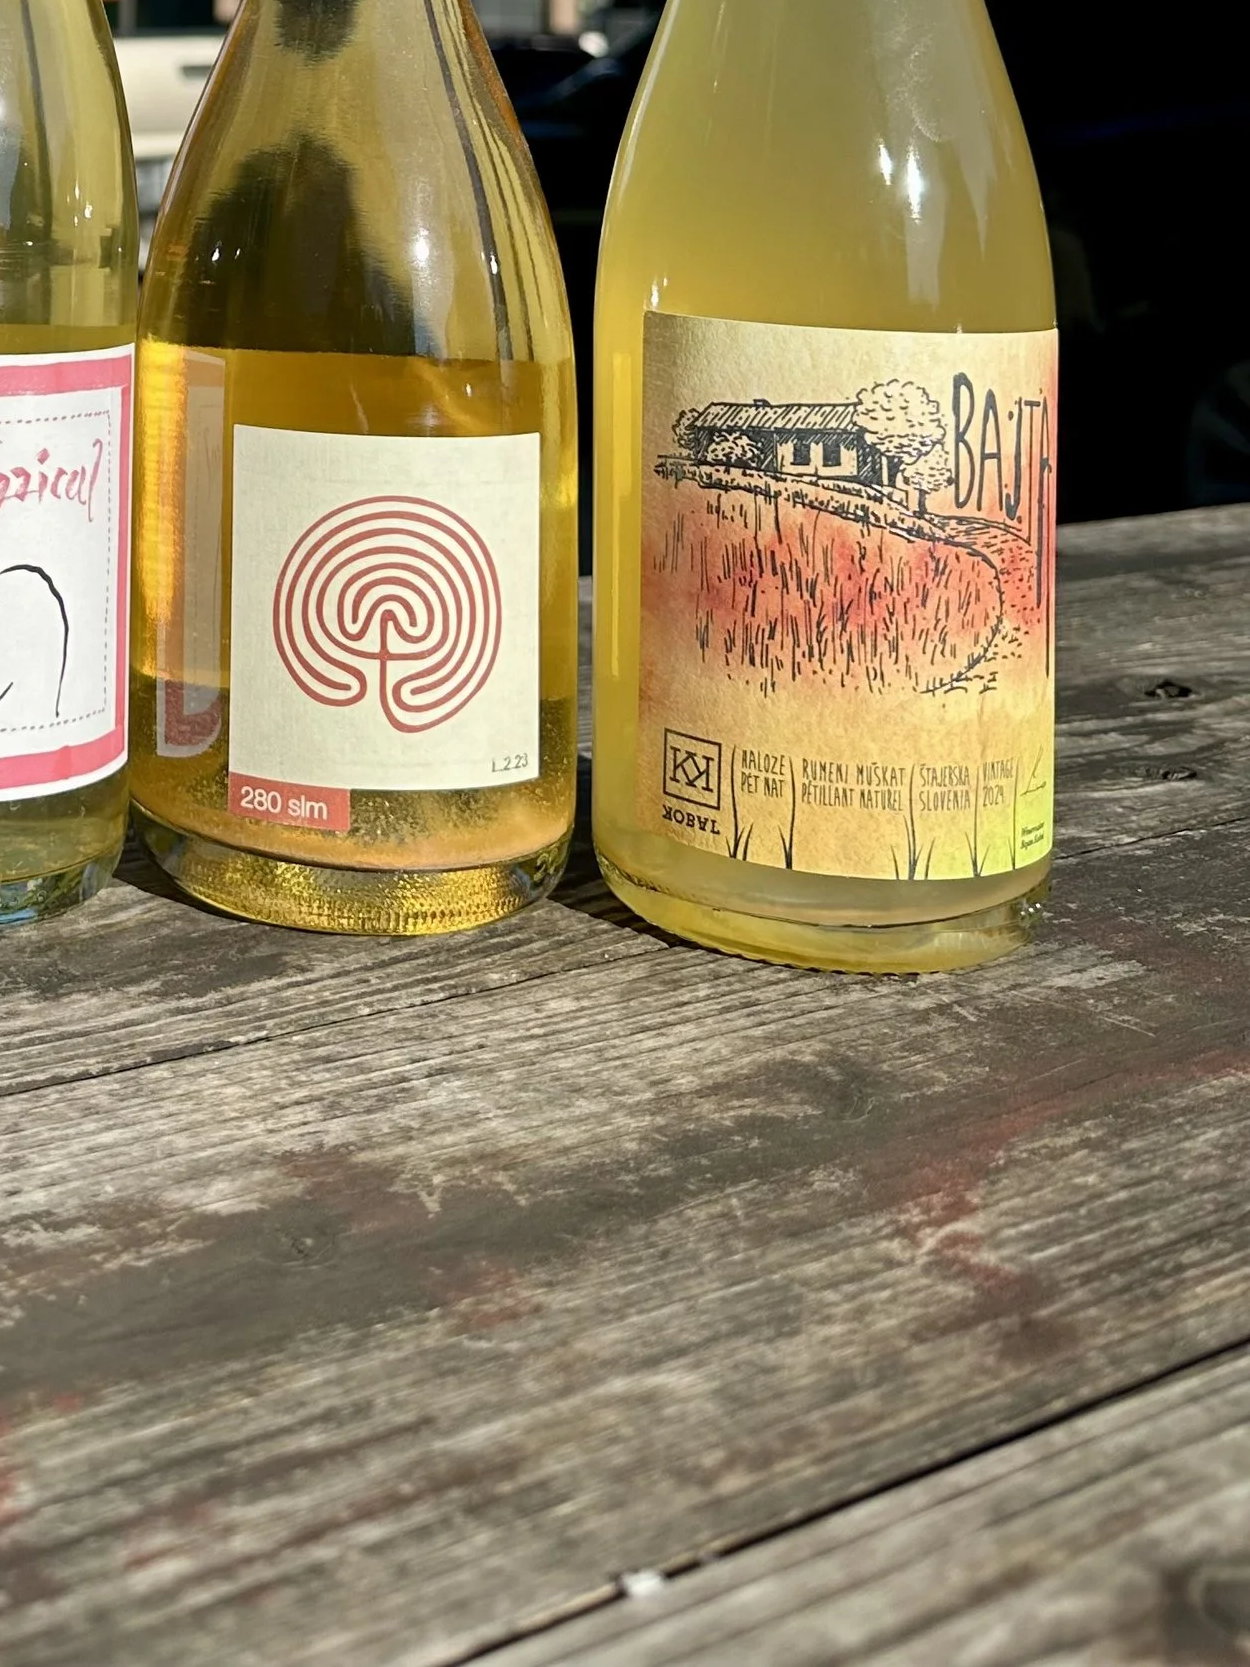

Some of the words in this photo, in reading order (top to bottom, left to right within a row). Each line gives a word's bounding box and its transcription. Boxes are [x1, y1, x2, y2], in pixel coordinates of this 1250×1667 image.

[952, 372, 1050, 679] BAJTA
[802, 758, 849, 784] RUMENI
[856, 762, 906, 787] MUŠKAT
[982, 757, 1014, 782] VINTAGE
[764, 777, 785, 798] NAT
[801, 780, 854, 807] PÉTILLANT
[859, 788, 903, 811] NATUREL
[919, 790, 971, 811] SLOVENIA
[982, 784, 1005, 807] 2024
[240, 786, 282, 813] 280
[287, 795, 328, 821] slm
